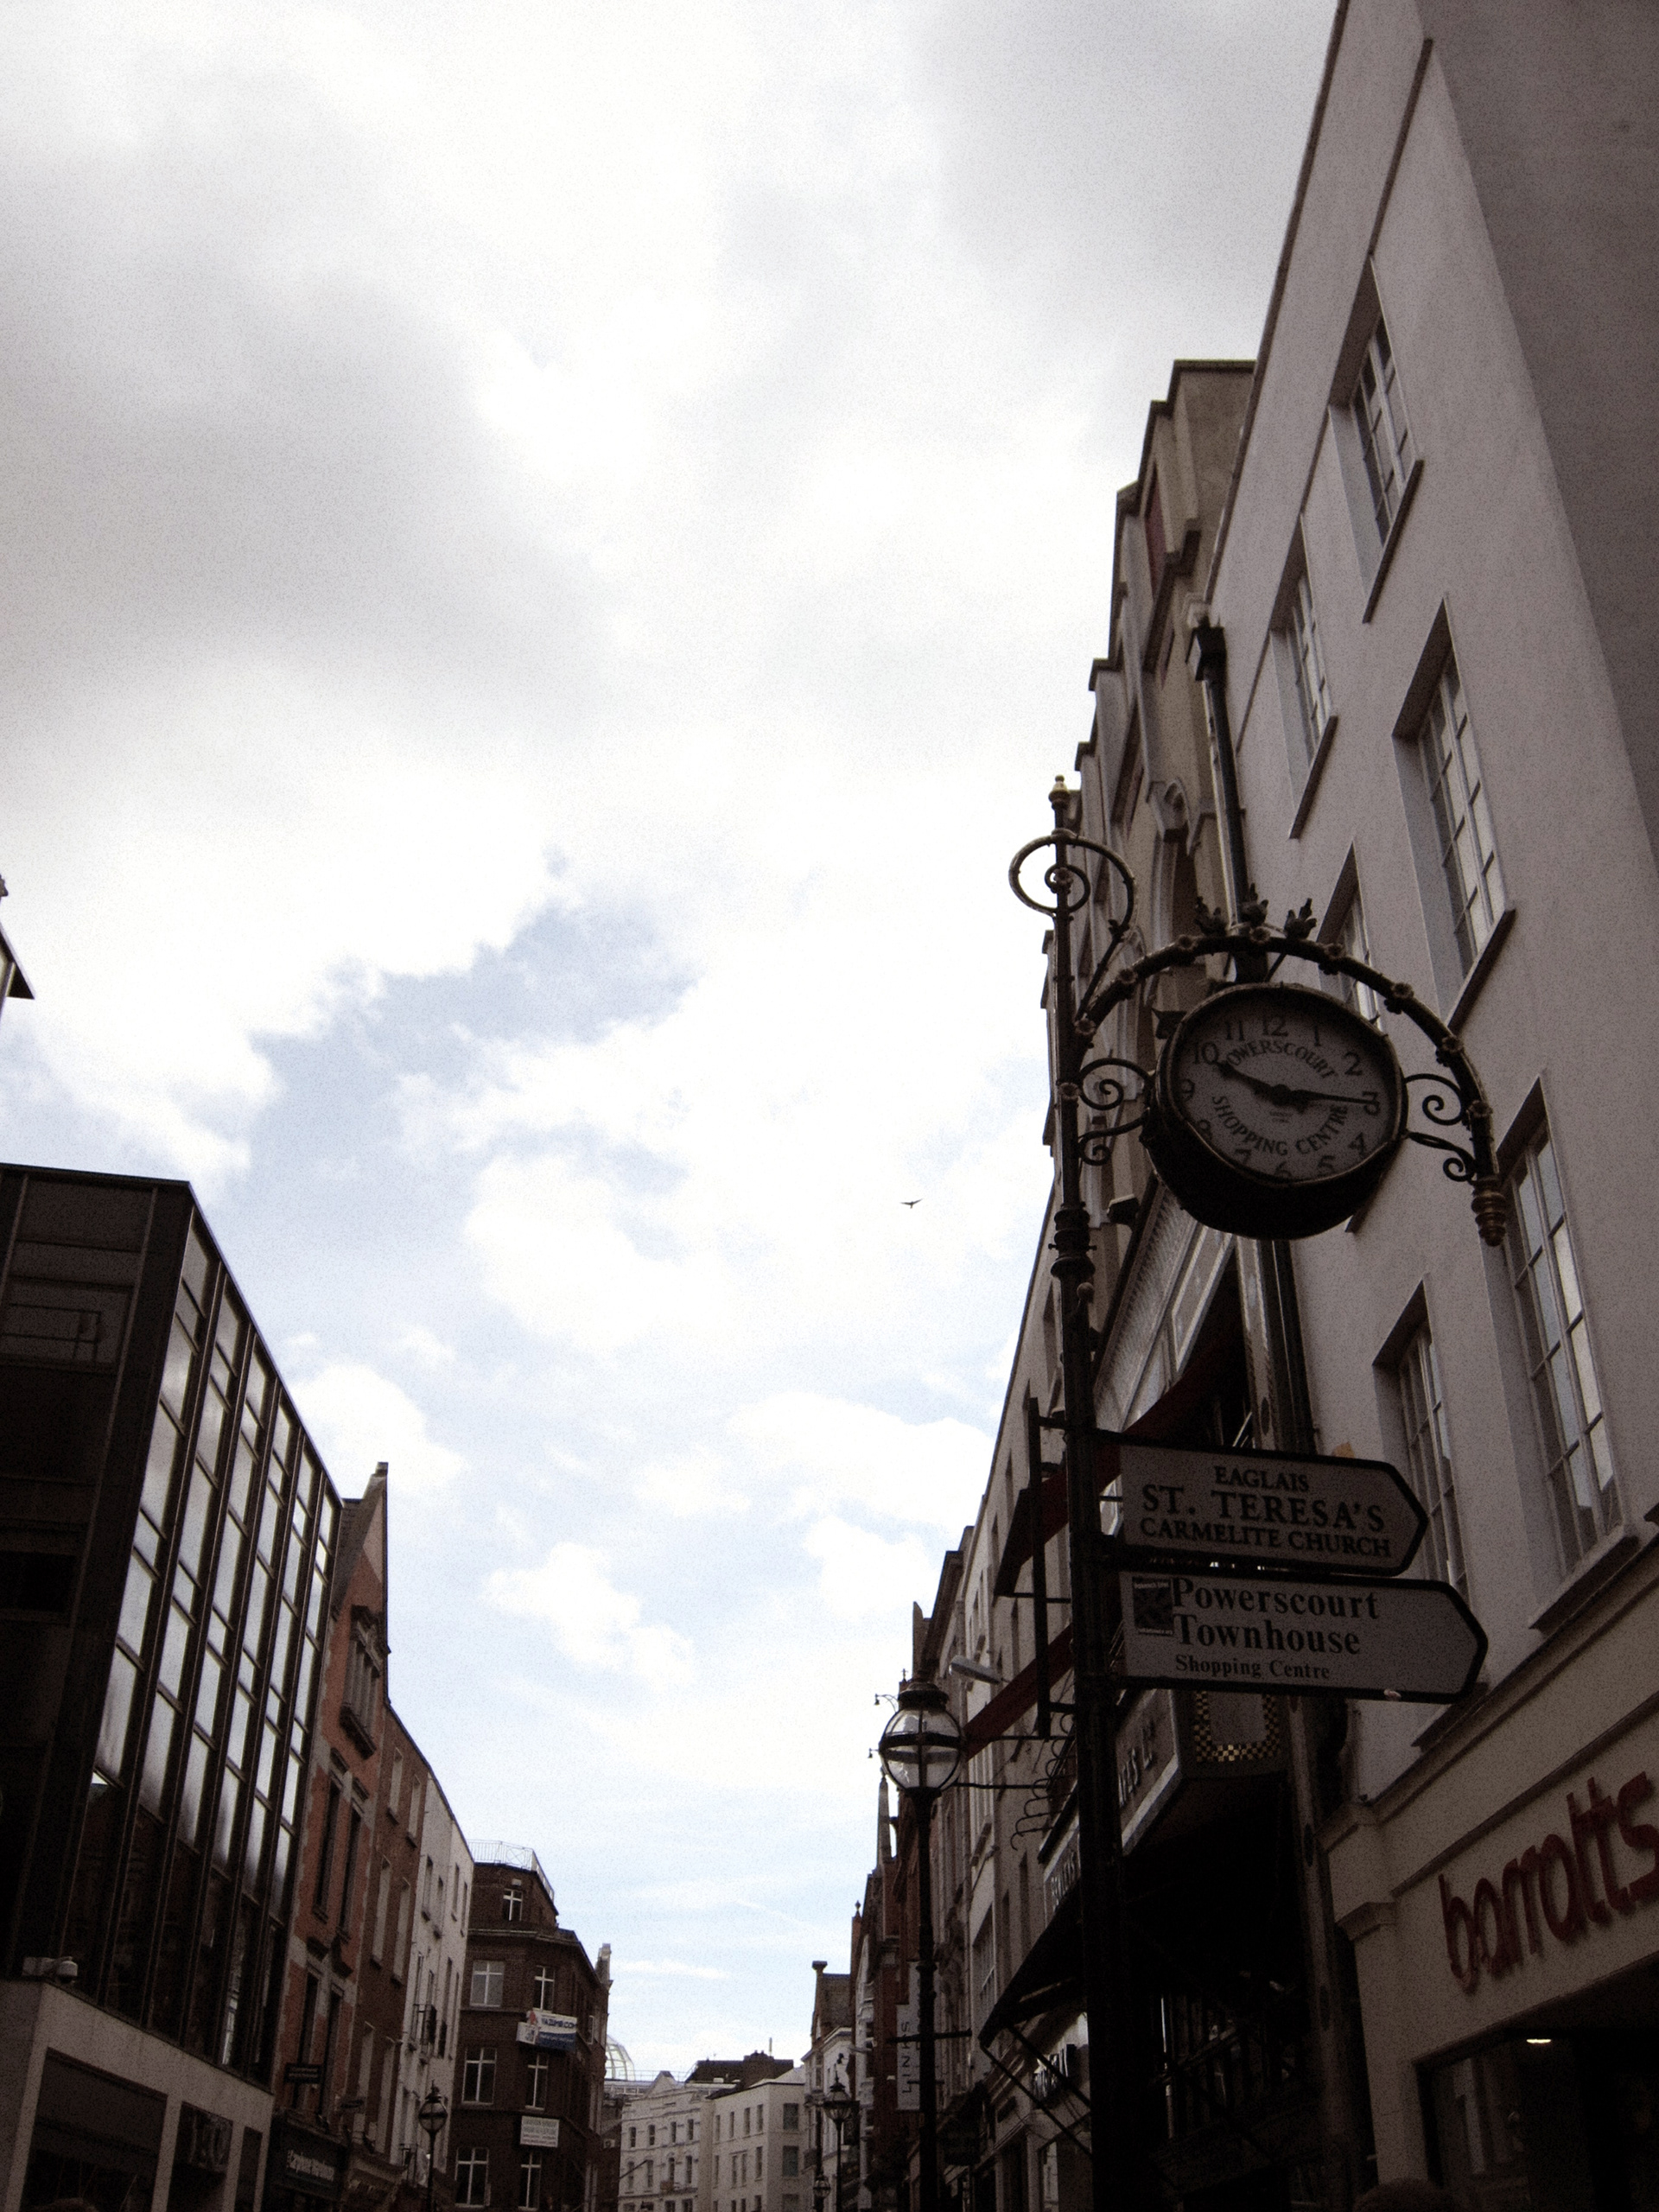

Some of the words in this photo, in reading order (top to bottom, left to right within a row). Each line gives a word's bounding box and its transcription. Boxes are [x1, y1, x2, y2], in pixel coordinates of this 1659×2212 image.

[1224, 1021, 1245, 1041] 11
[1262, 1014, 1289, 1037] 12
[1313, 1025, 1323, 1047] 1
[1192, 1042, 1219, 1065] 10
[1222, 1039, 1337, 1078] OWERSCOURT
[1342, 1052, 1363, 1077] 2
[1179, 1077, 1196, 1103] 9
[1211, 1096, 1288, 1156] SHOPPING
[1295, 1104, 1349, 1155] CENTRE
[1349, 1132, 1369, 1156] 4
[1318, 1154, 1337, 1178] 5
[1214, 1465, 1309, 1493] EAGLAIS
[1141, 1484, 1196, 1515] ST.
[1211, 1490, 1384, 1533] TERESA'S
[1140, 1517, 1281, 1548] CARMELITE
[1287, 1530, 1391, 1557] CHURCH
[1173, 1578, 1380, 1620] Powerscourt
[1173, 1614, 1362, 1656] Townhouse
[1175, 1654, 1262, 1679] Shopping
[1269, 1659, 1331, 1681] Centre
[1438, 1770, 1659, 1994] barratts
